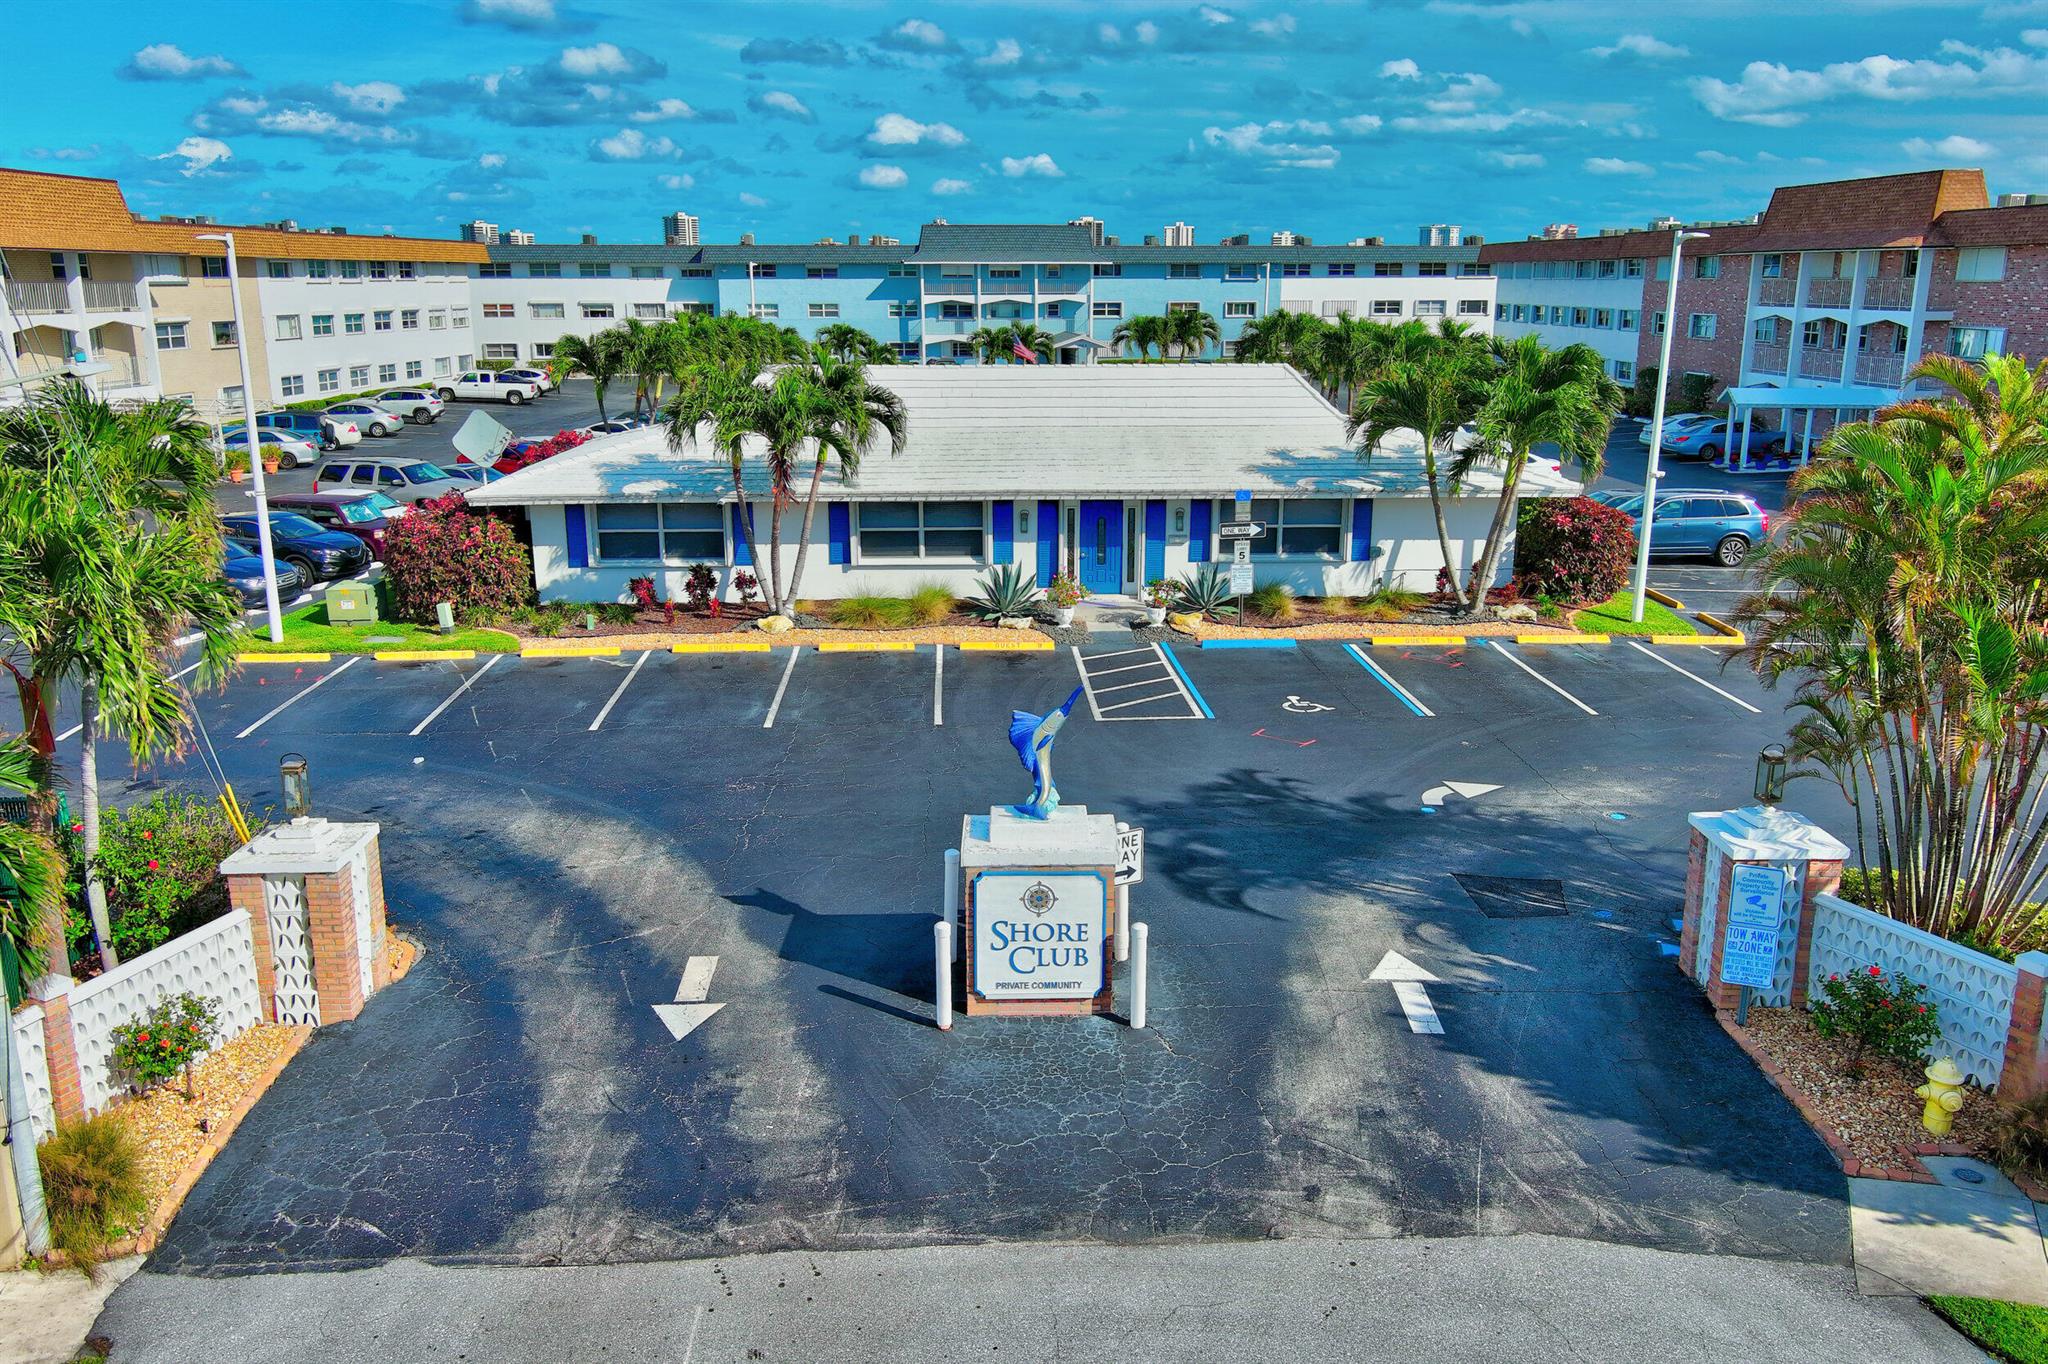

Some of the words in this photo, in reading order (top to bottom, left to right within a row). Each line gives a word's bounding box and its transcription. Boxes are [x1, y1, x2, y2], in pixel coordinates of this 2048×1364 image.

[1239, 552, 1246, 560] 5
[1121, 834, 1138, 848] NE
[1121, 848, 1139, 863] AY
[1742, 877, 1774, 885] Community
[1728, 928, 1747, 939] TOW
[1751, 931, 1775, 944] AWAY
[1738, 941, 1762, 954] ZONE
[995, 982, 1029, 990] PRIVATE
[1031, 981, 1081, 989] COMMUNITY
